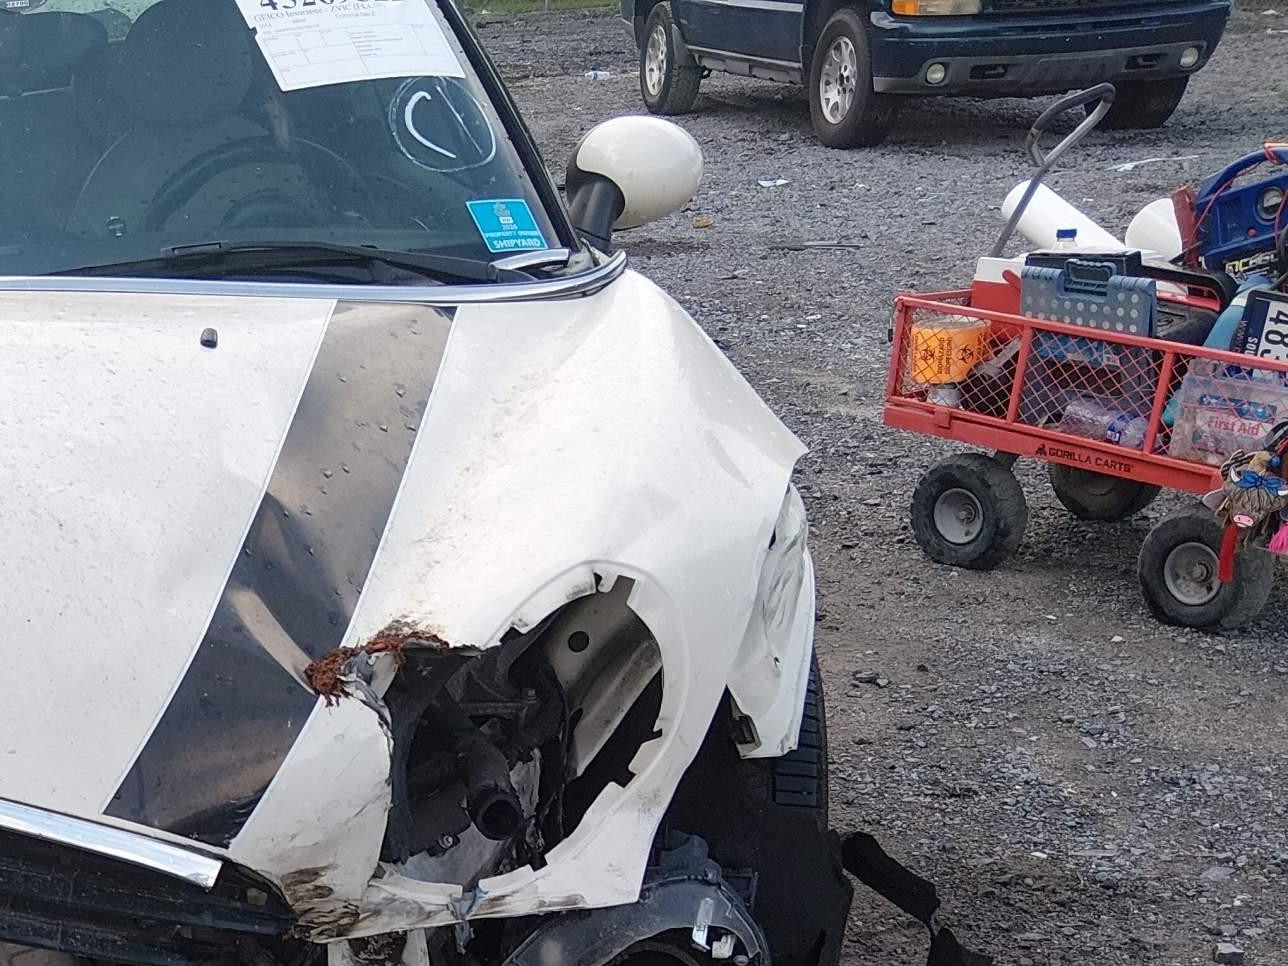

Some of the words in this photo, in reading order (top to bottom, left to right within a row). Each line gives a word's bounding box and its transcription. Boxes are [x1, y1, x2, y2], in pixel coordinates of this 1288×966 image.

[492, 238, 541, 249] SHIPYARD
[1208, 415, 1236, 433] First
[1238, 422, 1260, 436] Aid
[1048, 447, 1092, 465] GORILLA
